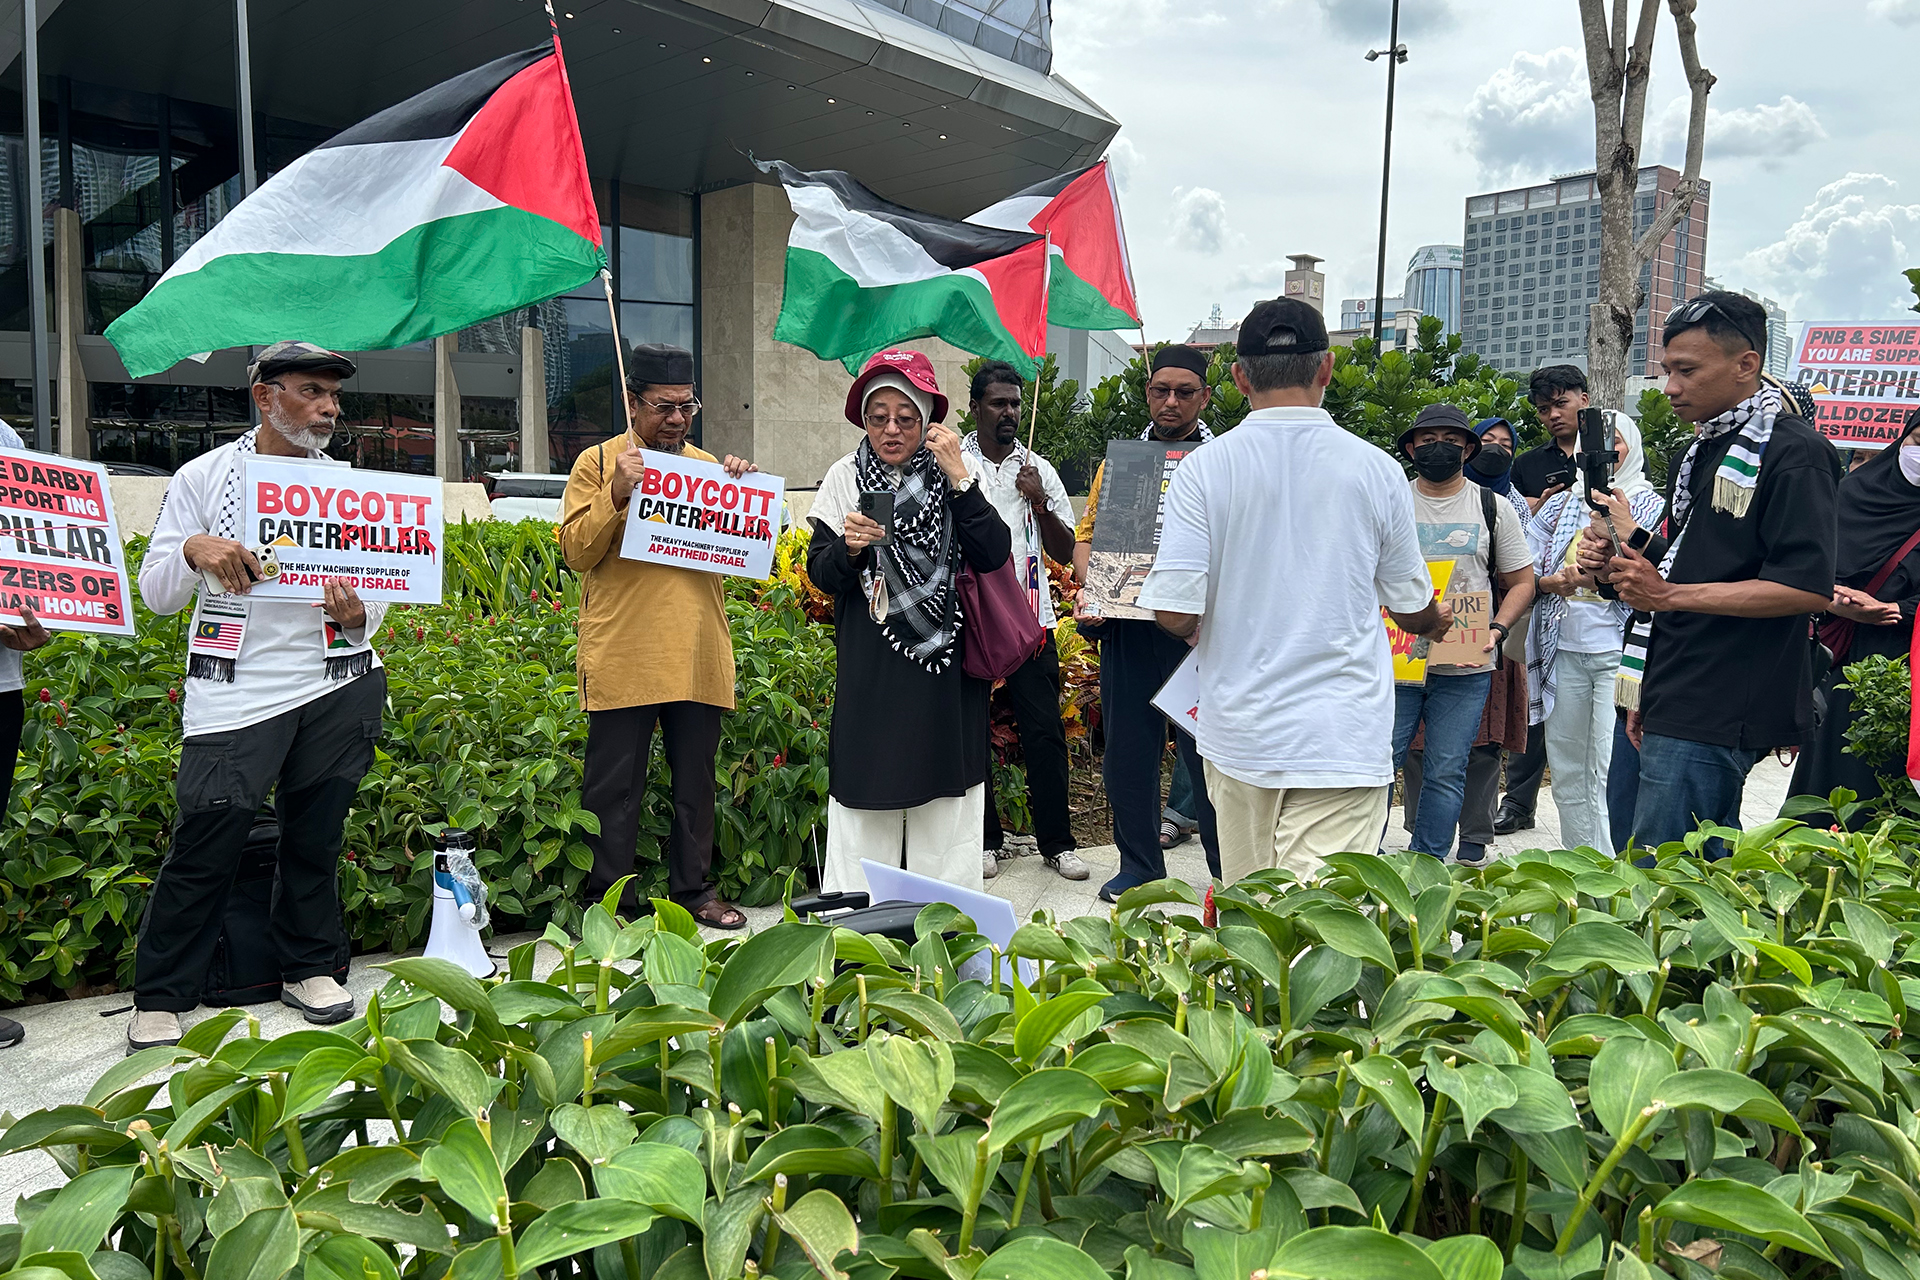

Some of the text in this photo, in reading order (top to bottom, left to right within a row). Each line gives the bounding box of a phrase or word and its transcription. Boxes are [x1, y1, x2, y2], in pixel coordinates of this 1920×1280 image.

[1809, 330, 1847, 344] PNB
[1849, 330, 1864, 344] &
[1868, 330, 1917, 344] SIME
[1807, 348, 1920, 362] YOU ARE SUPP
[11, 462, 93, 494] DARBY
[257, 481, 432, 526] BOYCOTT
[640, 467, 776, 517] BOYCOTT
[648, 543, 747, 568] APARTHEID ISRAEL
[650, 534, 749, 557] THE HEAVY MACHINERY SUPPLIER OF
[280, 562, 410, 577] THE HEAVY MACHINERY SUPPLIER OF
[82, 575, 116, 597] OF
[361, 576, 410, 591] ISRAEL
[43, 596, 120, 619] HOMES
